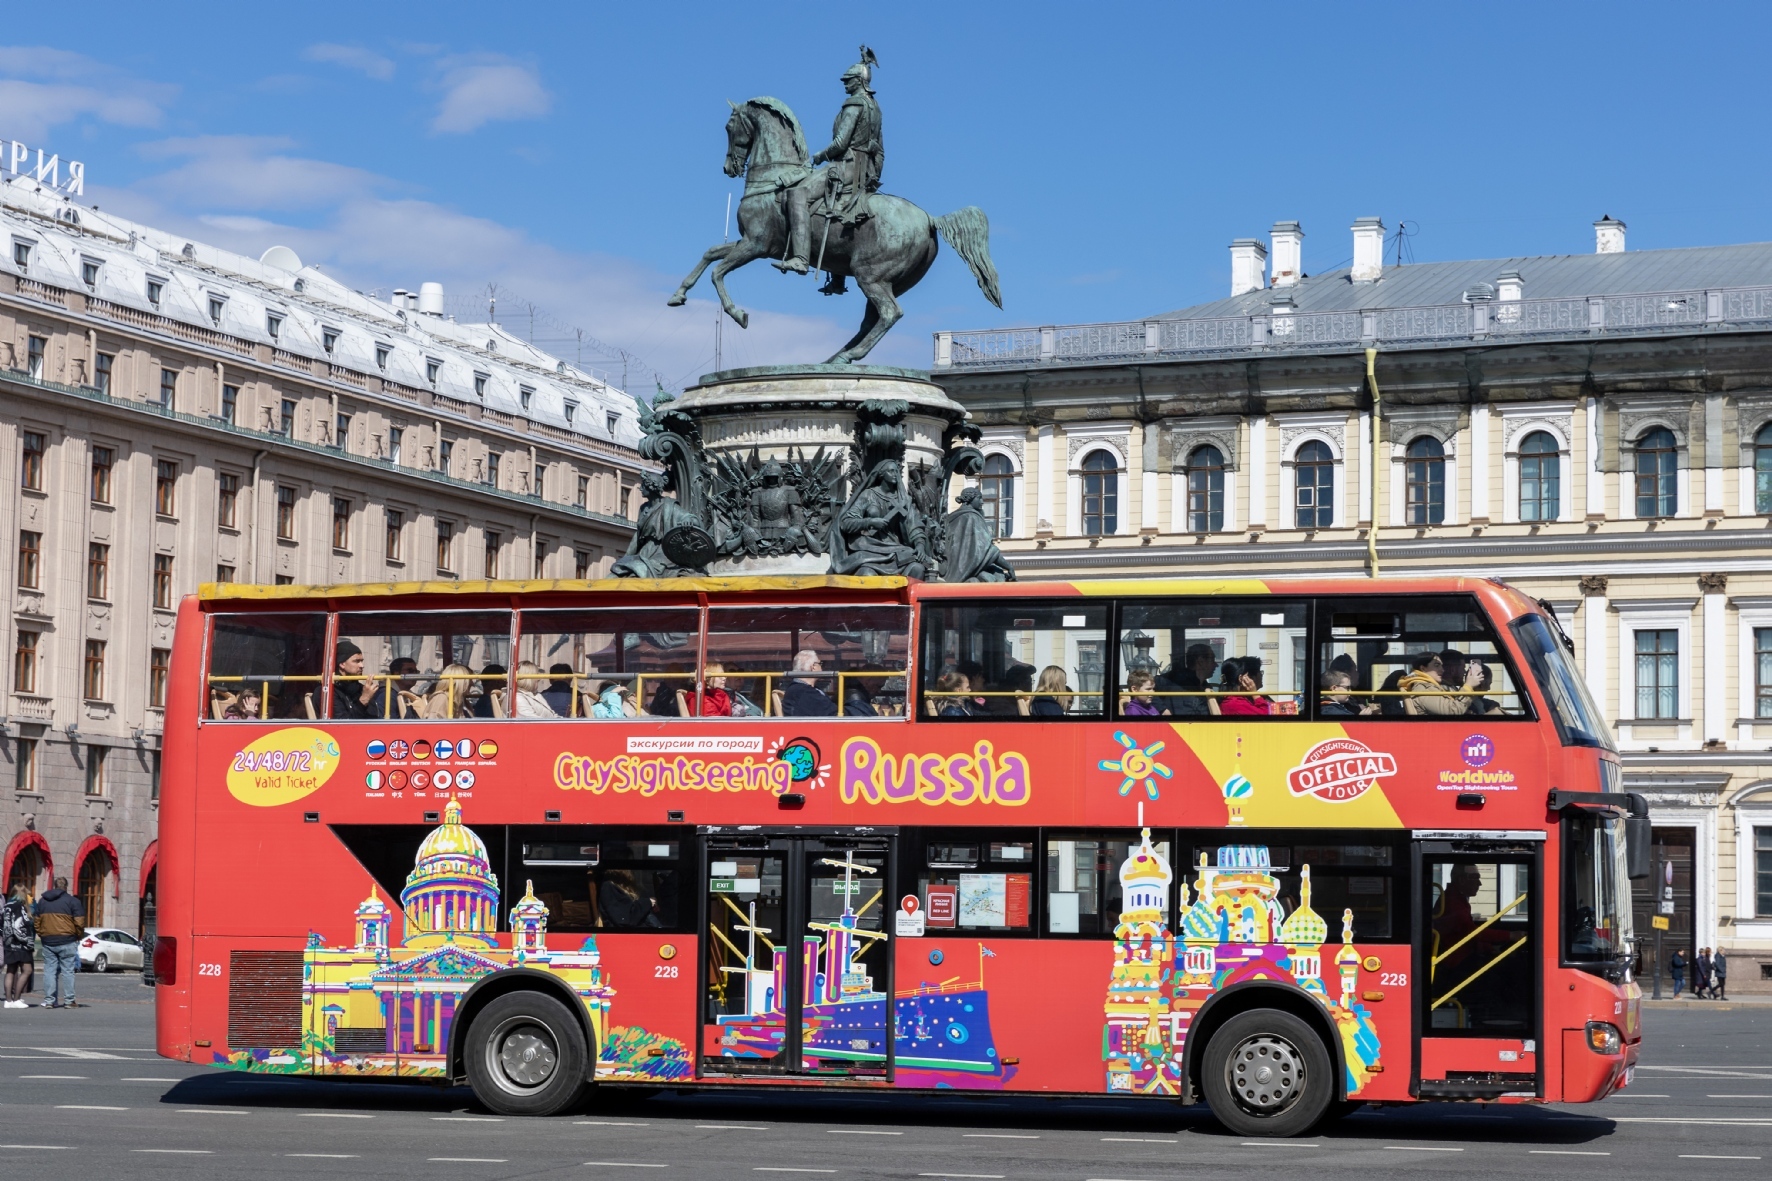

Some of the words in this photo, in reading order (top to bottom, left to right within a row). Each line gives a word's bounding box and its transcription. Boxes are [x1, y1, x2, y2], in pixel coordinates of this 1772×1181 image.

[0, 140, 84, 196] РИЯ
[630, 740, 694, 749] экскурсии
[698, 740, 713, 748] по
[716, 740, 760, 749] городу
[1310, 742, 1365, 762] CITYSIGHTSEEING
[234, 750, 311, 772] 24/48/72
[313, 757, 327, 770] hr
[840, 736, 1031, 806] Russia
[1299, 757, 1390, 789] OFFICIAL
[1440, 769, 1515, 784] Worldwide
[255, 776, 281, 788] Valid
[286, 775, 318, 789] Ticket
[1327, 780, 1368, 798] TOUR
[198, 963, 222, 976] 228
[654, 966, 679, 978] 228
[1380, 973, 1407, 986] 228
